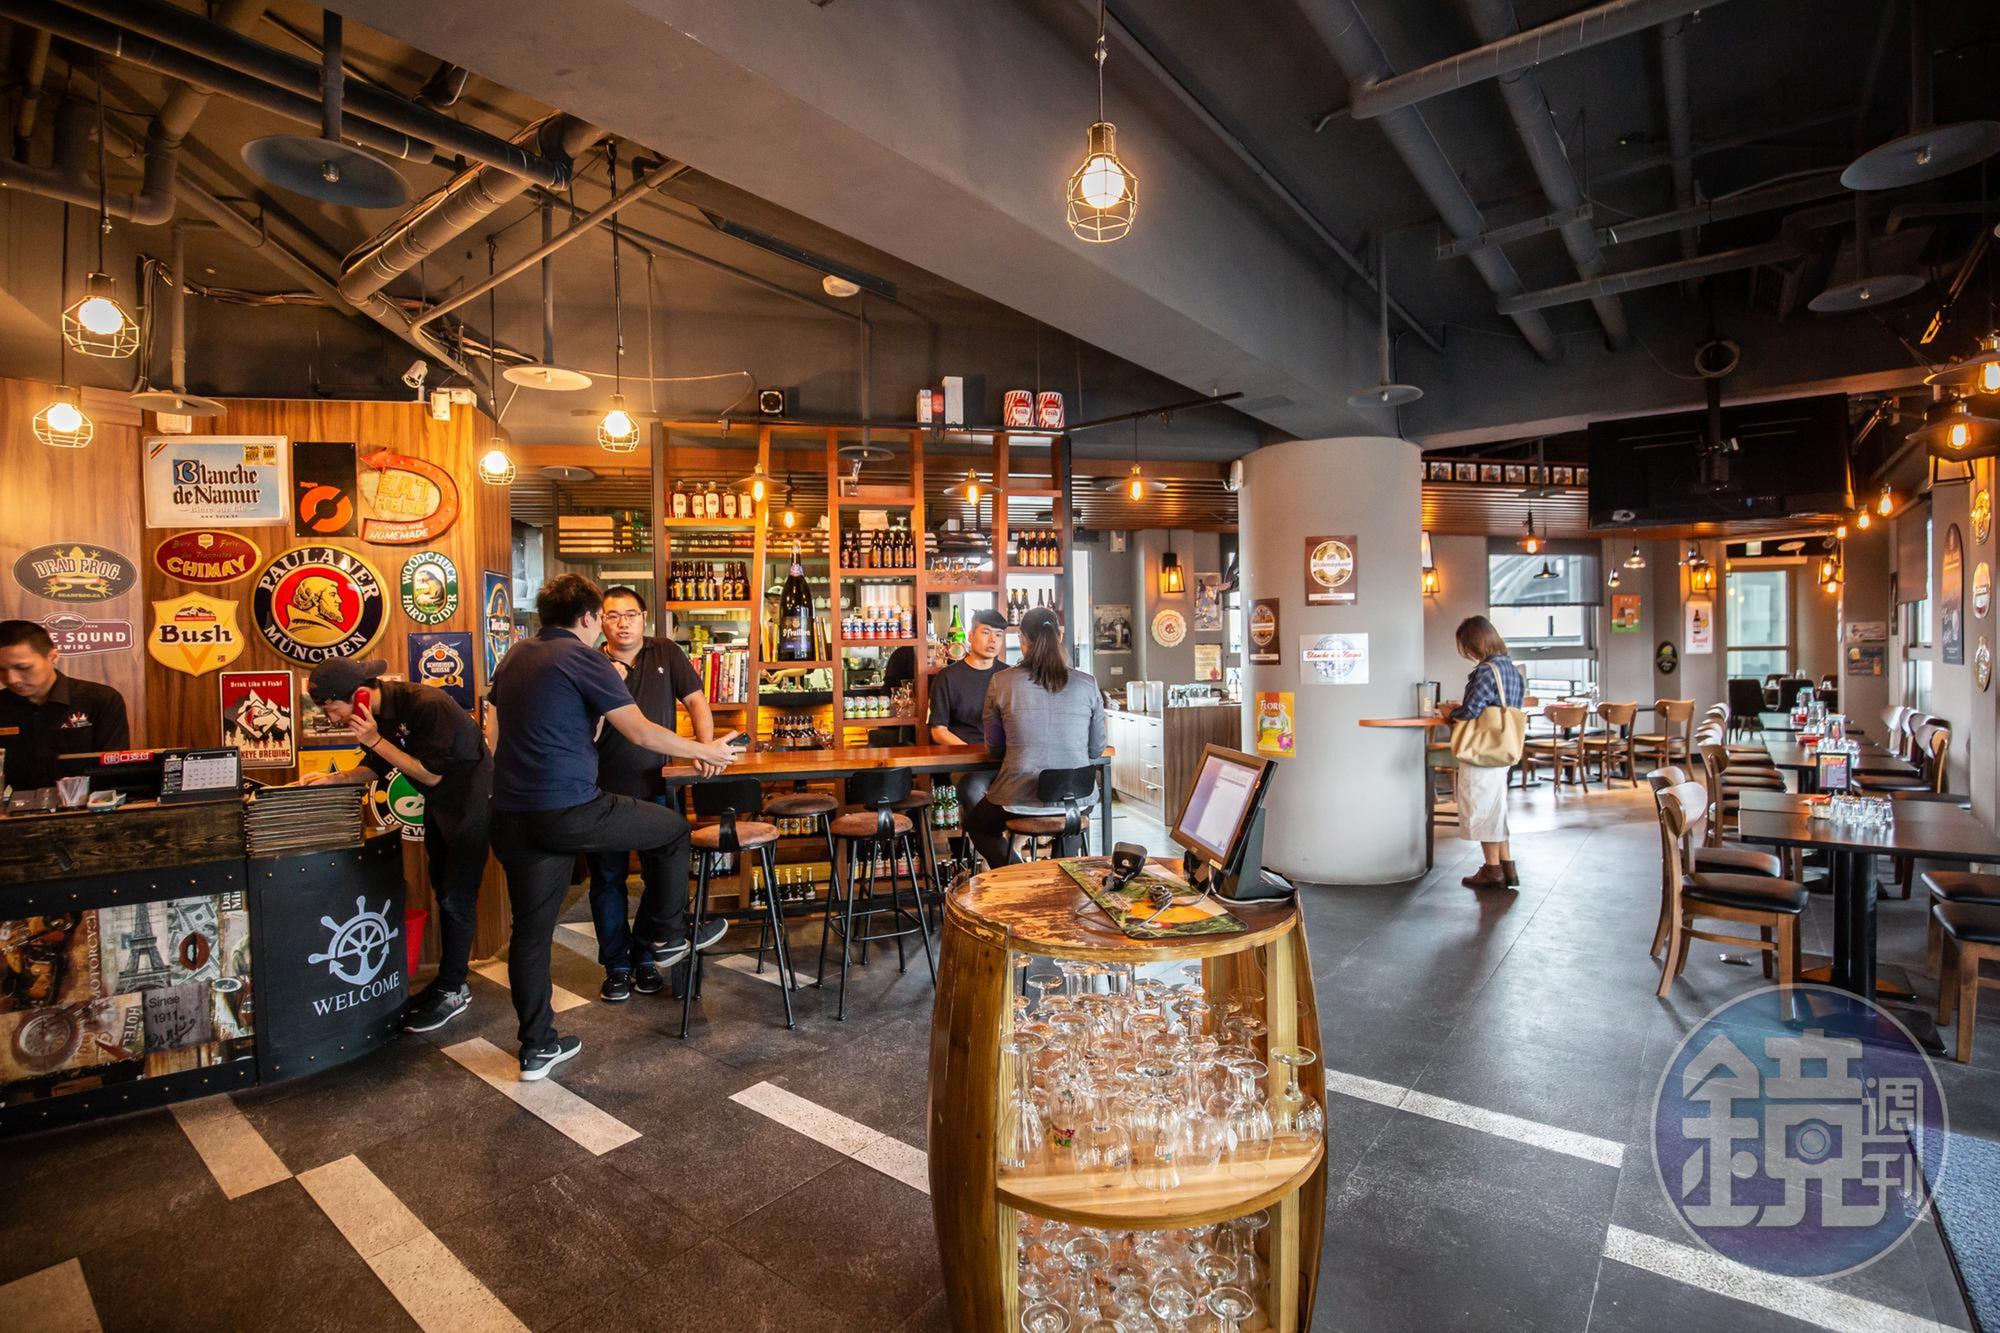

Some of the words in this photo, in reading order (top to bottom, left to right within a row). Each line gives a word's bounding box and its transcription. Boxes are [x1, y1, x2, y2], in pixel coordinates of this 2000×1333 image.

[174, 460, 258, 485] Blanche
[173, 486, 193, 504] de
[195, 486, 260, 504] Namur
[379, 474, 431, 500] EAT
[369, 528, 429, 541] HOMEMADE
[32, 559, 76, 578] DEAD
[79, 559, 121, 580] FROG
[167, 555, 246, 578] CHIMAY
[258, 548, 380, 601] PAULANER
[402, 551, 457, 585] WOODCHUCK
[402, 594, 427, 624] HARD
[429, 594, 457, 625] CIDER
[66, 632, 126, 642] SOUND
[159, 625, 232, 643] Bush
[264, 624, 367, 662] MÜNCHEN
[259, 749, 290, 759] BREWING
[148, 995, 181, 1008] Since
[312, 971, 400, 1016] WELCOME
[122, 1006, 141, 1046] HOTEL
[152, 1011, 178, 1025] 1911
